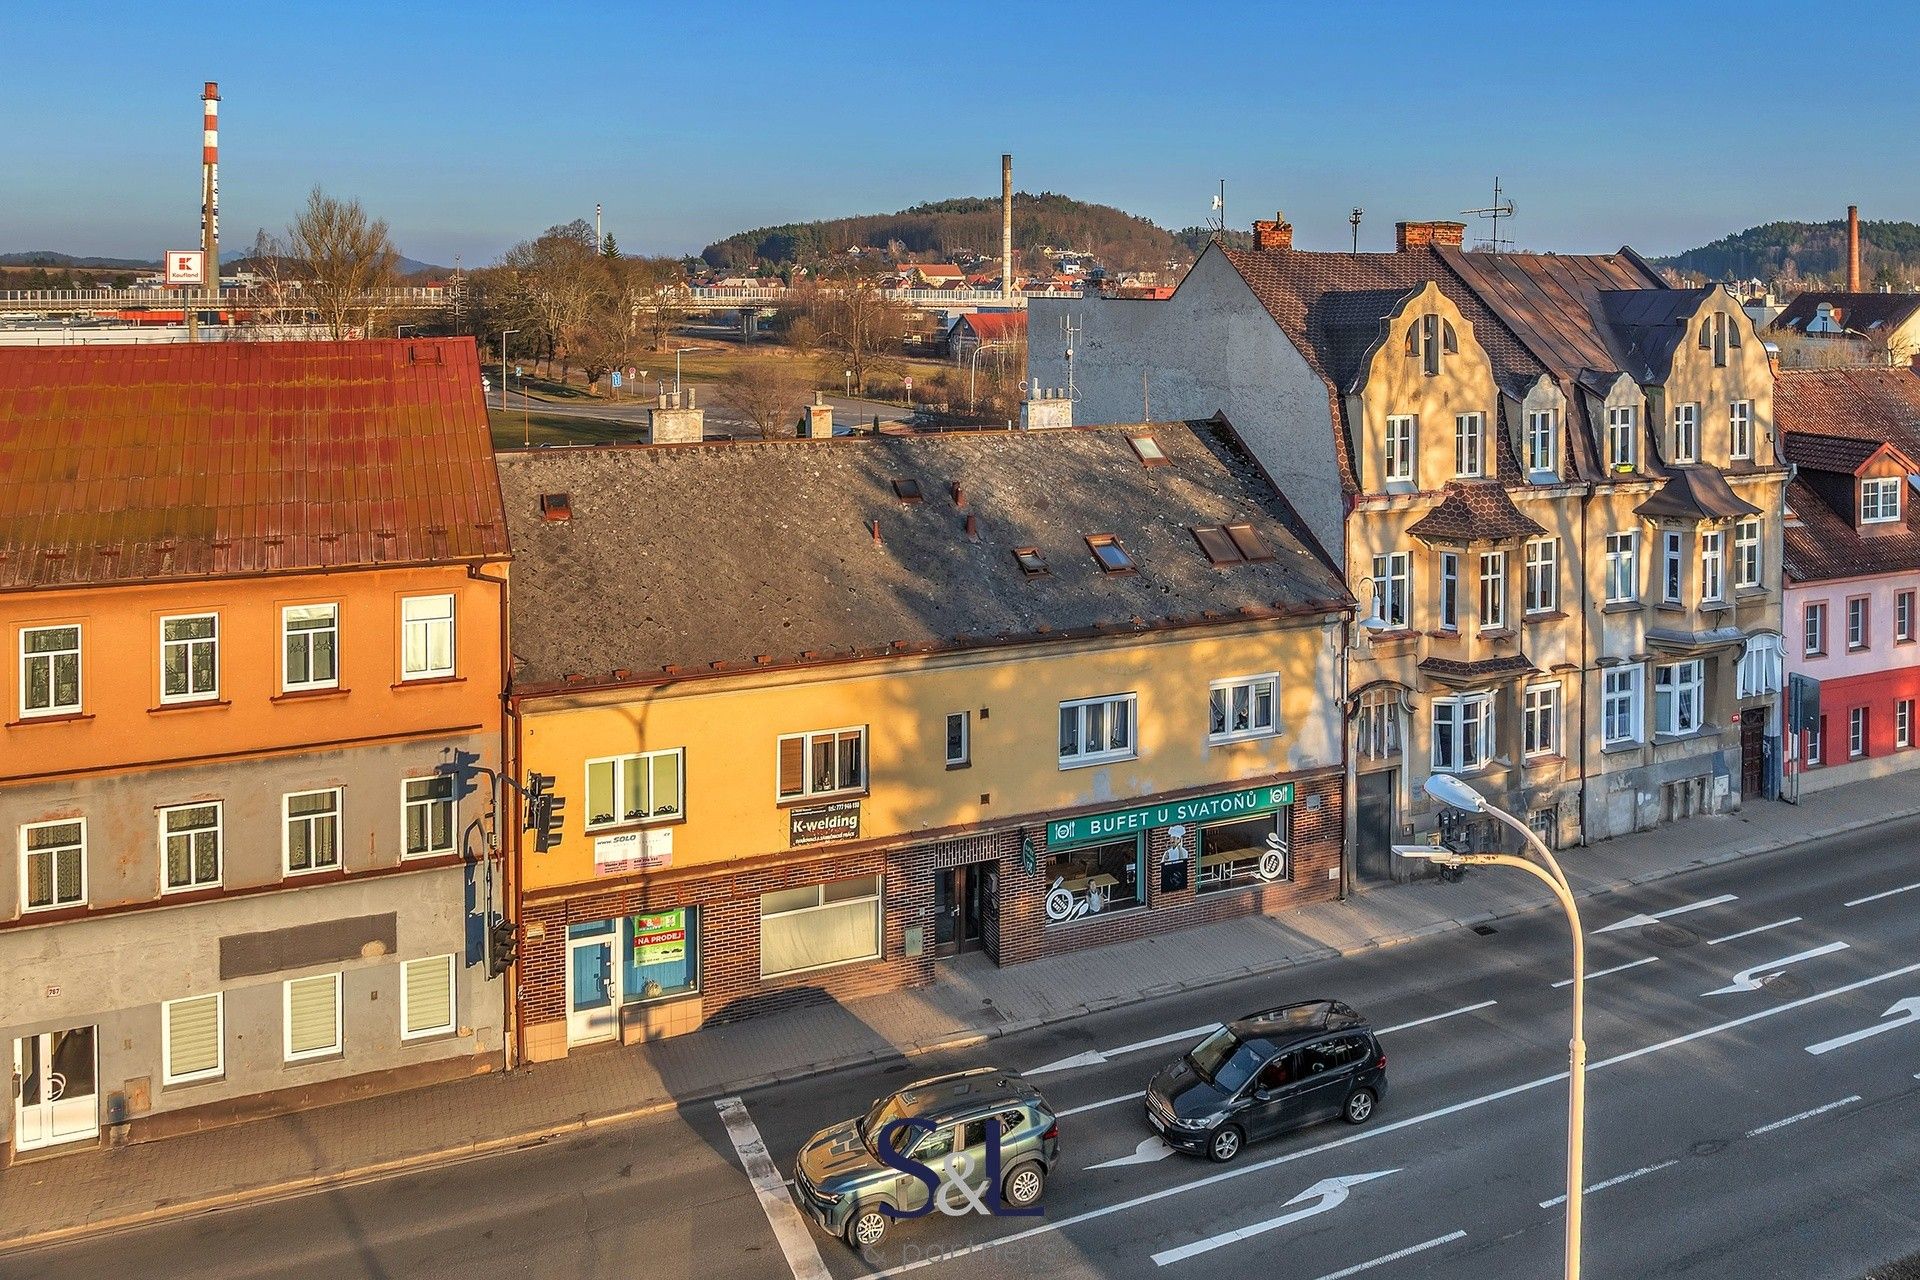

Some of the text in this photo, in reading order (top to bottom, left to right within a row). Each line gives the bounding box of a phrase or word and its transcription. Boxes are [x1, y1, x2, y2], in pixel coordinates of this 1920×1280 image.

[1090, 791, 1257, 835] BUFET U SVATOŇŮ
[793, 815, 858, 833] K-welding
[613, 835, 637, 844] SOLO
[638, 932, 681, 945] NA PRODEJ
